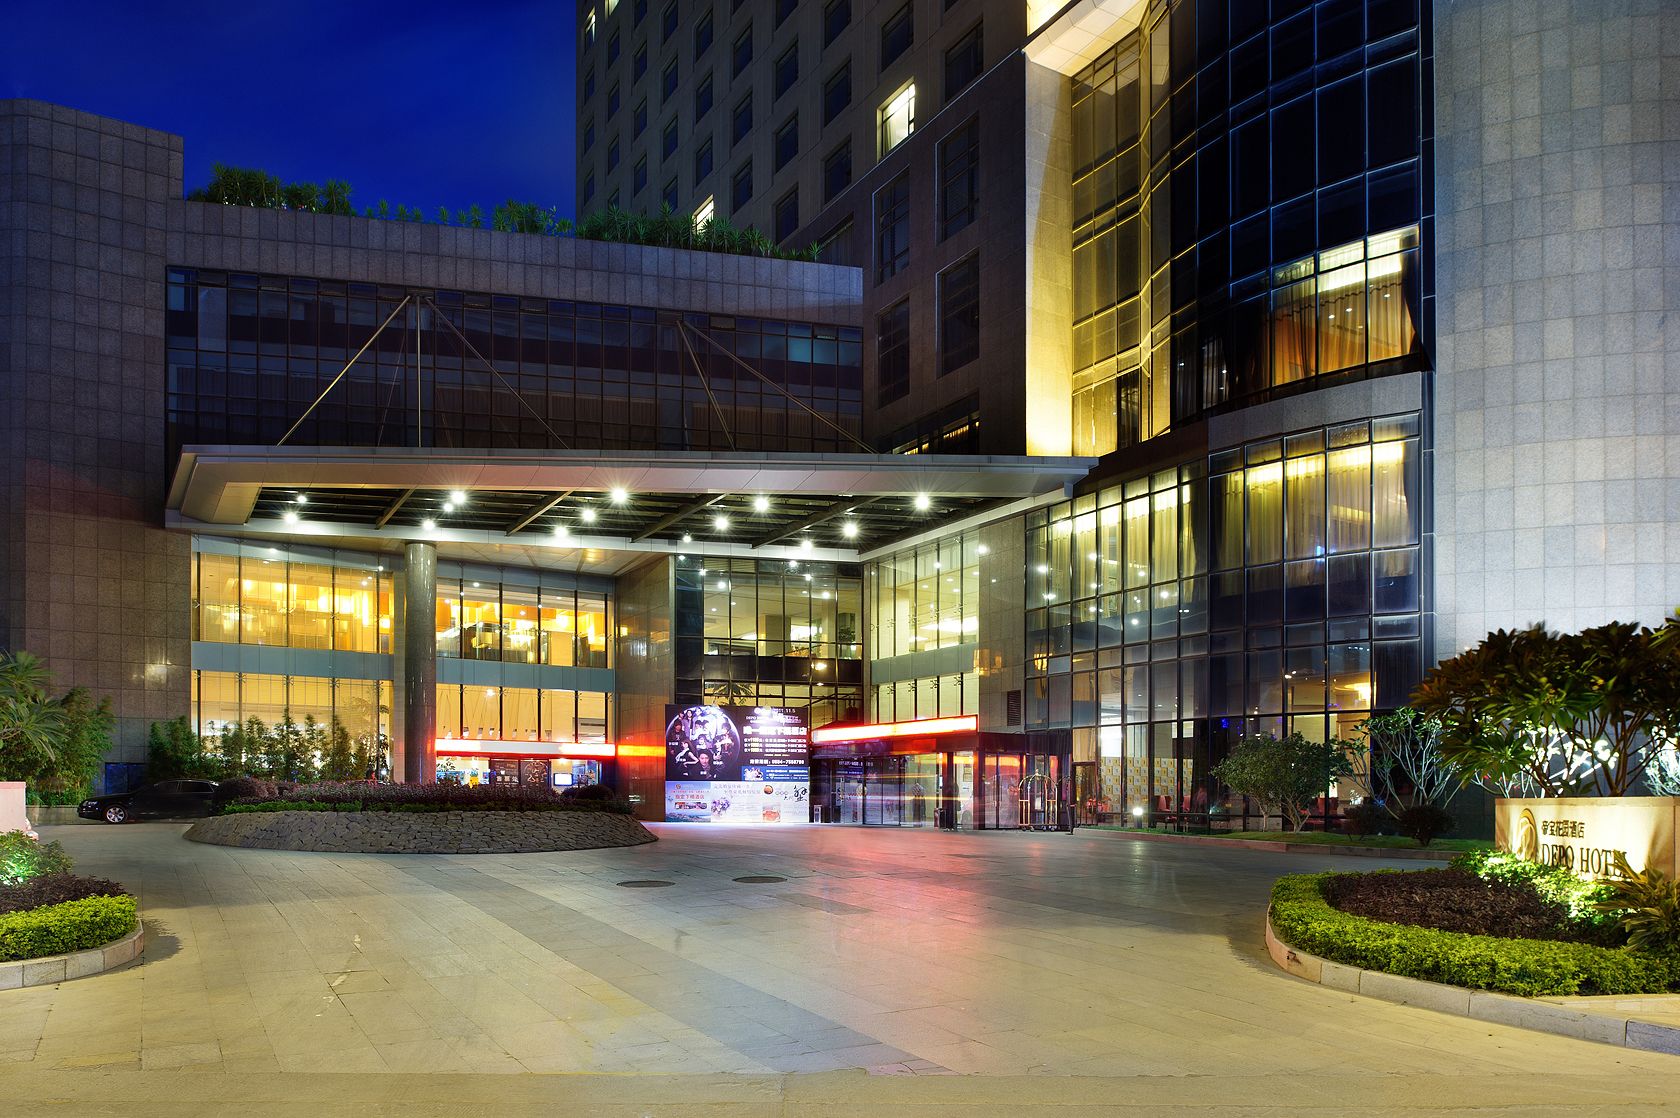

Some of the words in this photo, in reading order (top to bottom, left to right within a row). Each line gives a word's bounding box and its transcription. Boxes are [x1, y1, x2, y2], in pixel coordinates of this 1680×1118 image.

[1542, 820, 1585, 838] 帝宝花园酒店
[1542, 844, 1575, 870] DEPO
[1580, 848, 1631, 878] HOTE
